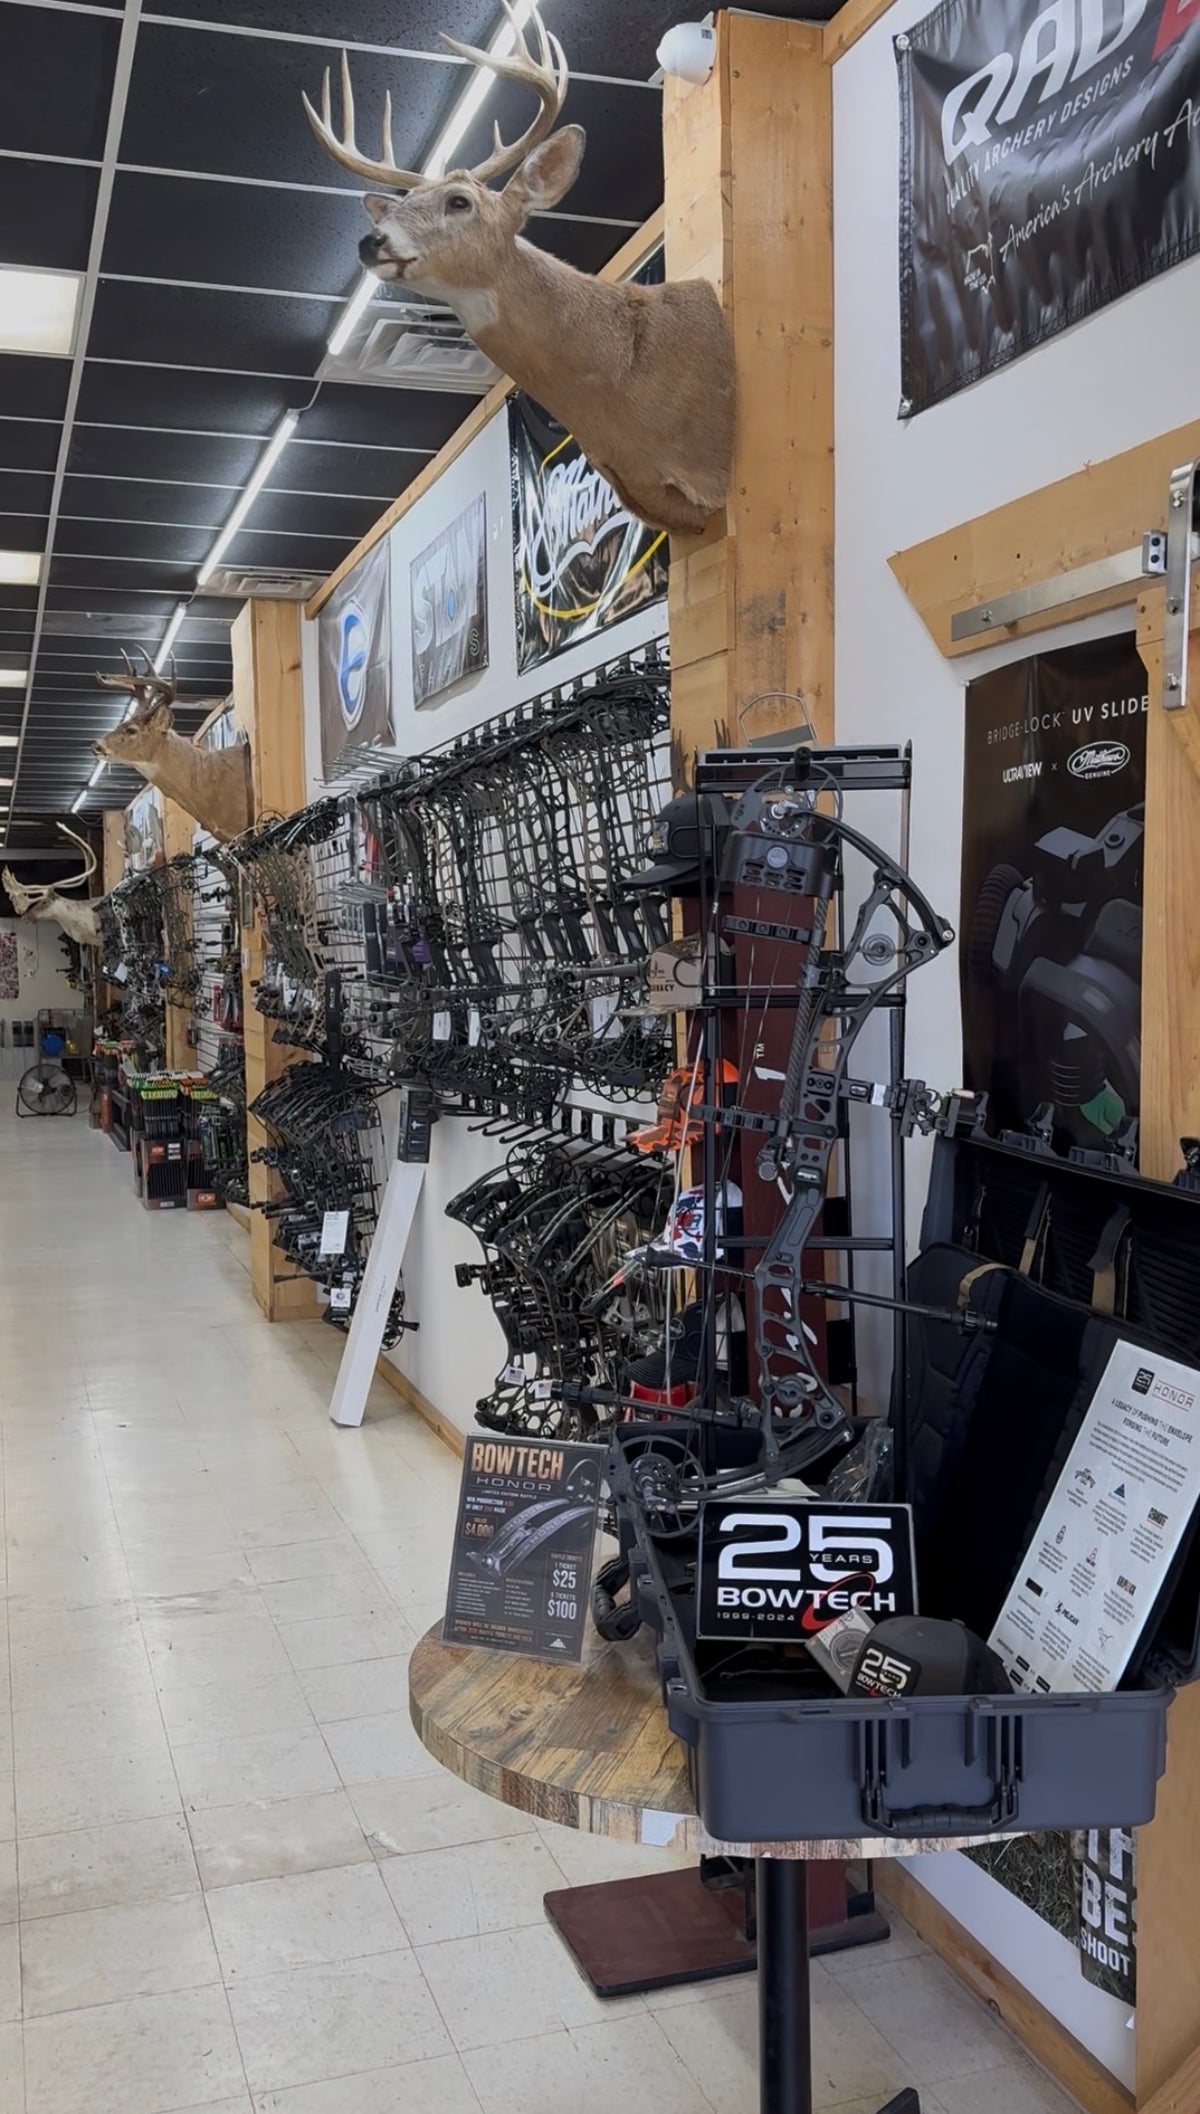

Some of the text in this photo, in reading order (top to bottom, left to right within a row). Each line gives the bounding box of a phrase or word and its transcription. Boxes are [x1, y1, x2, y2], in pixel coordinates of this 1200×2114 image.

[941, 0, 1148, 165] QAD
[946, 54, 1135, 215] UALITY ARCHERY DESIGNS
[1000, 184, 1070, 262] America's
[1074, 131, 1158, 205] Archery
[1072, 706, 1094, 724] UV
[1085, 770, 1112, 780] GENUINE
[1153, 1383, 1194, 1408] HONOR
[471, 1442, 564, 1480] BOWTECH
[476, 1477, 551, 1492] HONOR
[718, 1513, 894, 1584] 25
[809, 1553, 873, 1564] YEARS
[560, 1562, 577, 1570] TICKET
[552, 1569, 577, 1589] $25
[555, 1592, 577, 1601] TICKETS
[717, 1586, 896, 1612] BOWTECH
[547, 1599, 577, 1620] $100
[717, 1612, 795, 1621] 1999-2024
[861, 1648, 912, 1690] 25
[857, 1672, 902, 1699] BOWTECH
[1082, 1862, 1129, 1947] BE
[1080, 1926, 1131, 1977] SHOOT
